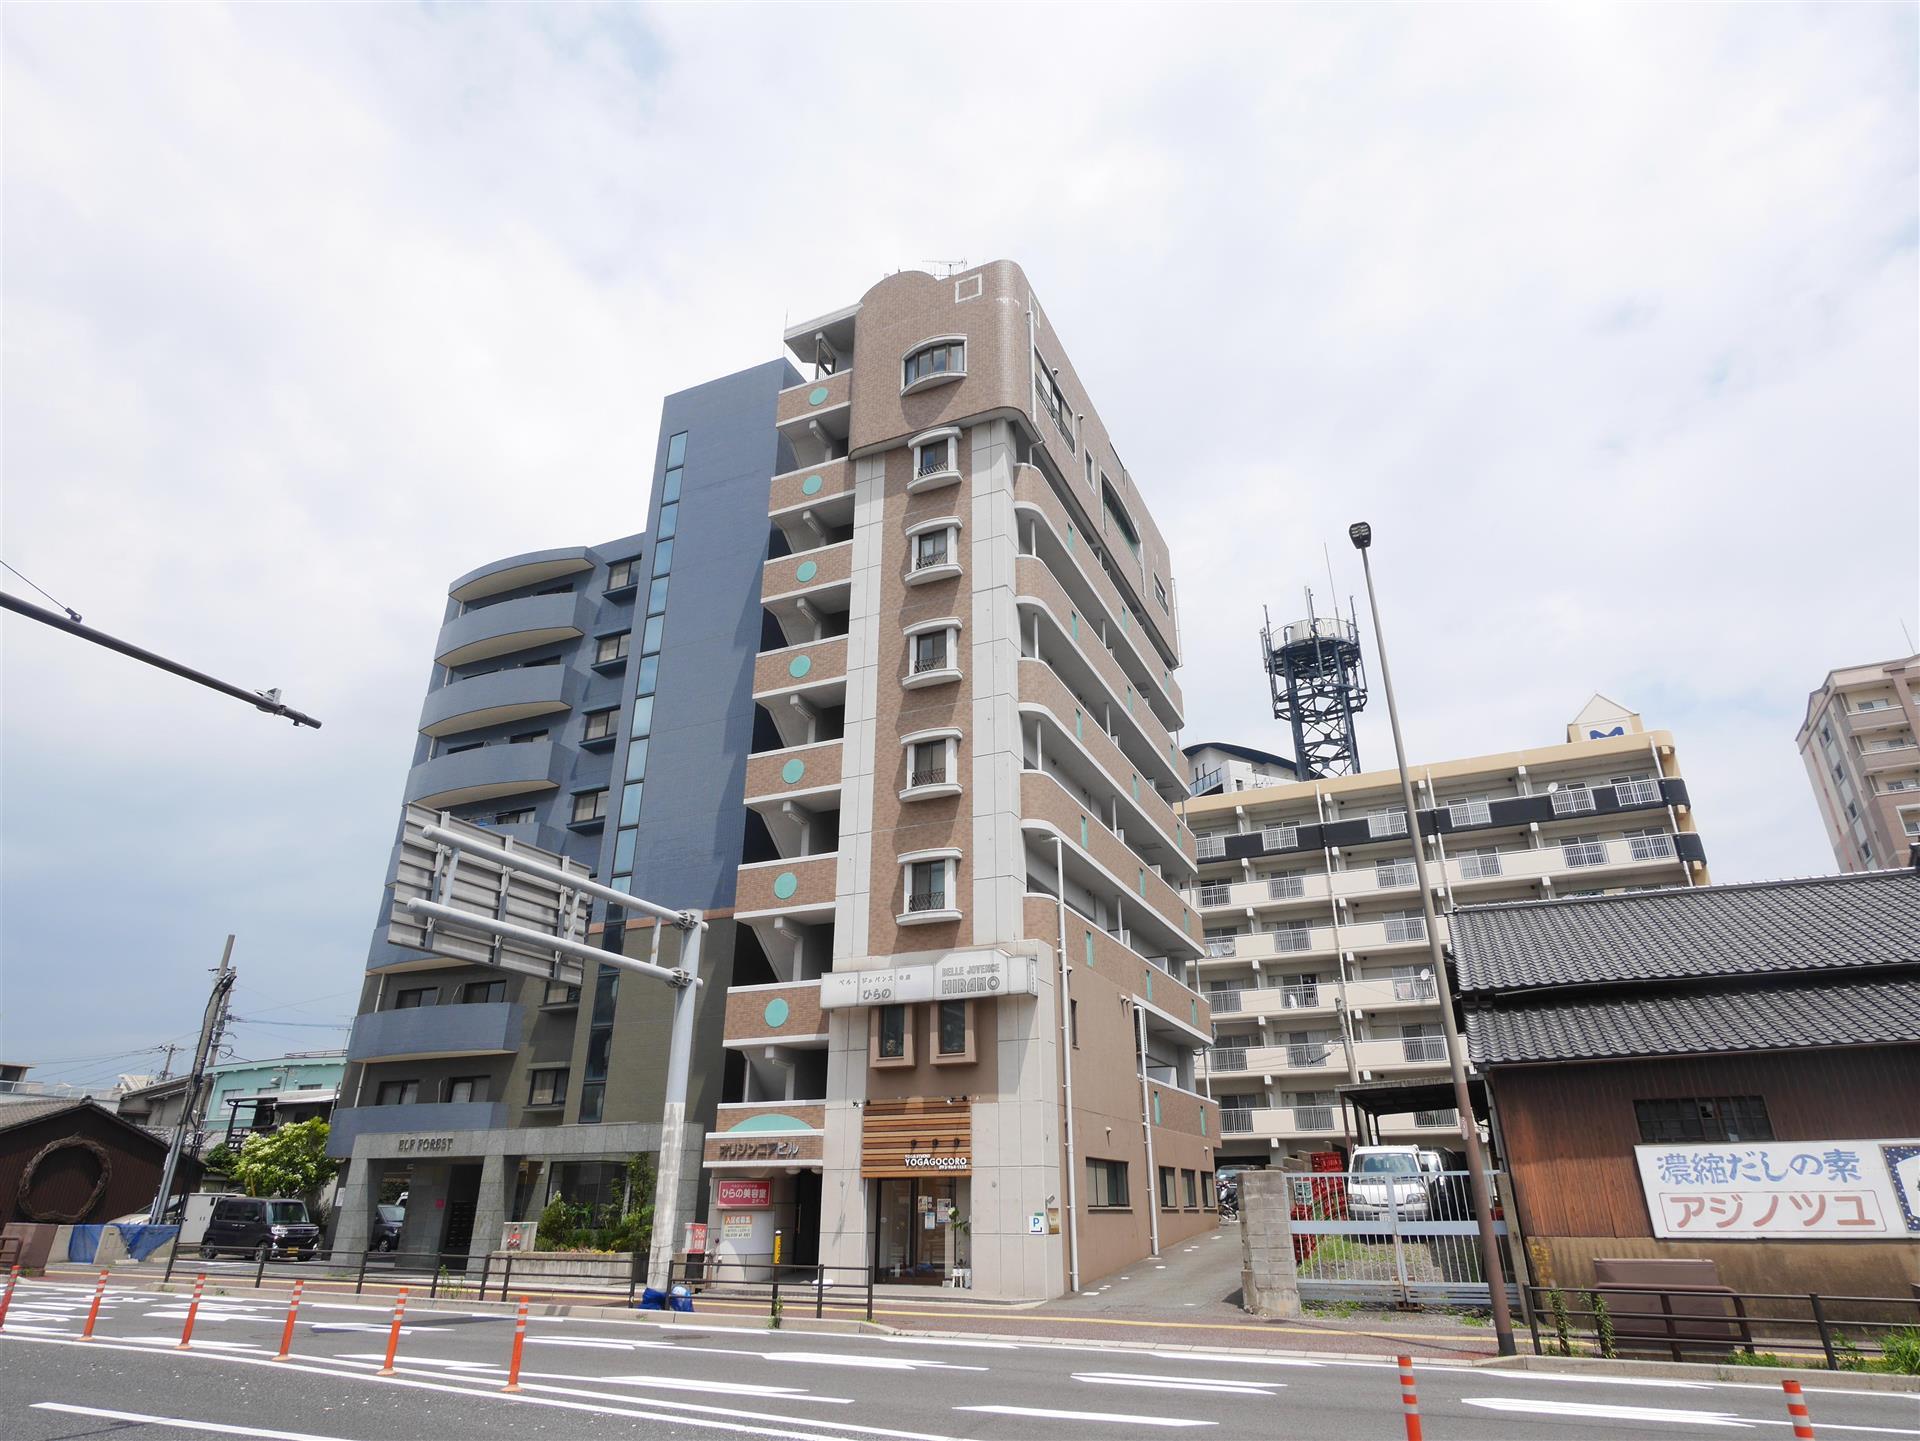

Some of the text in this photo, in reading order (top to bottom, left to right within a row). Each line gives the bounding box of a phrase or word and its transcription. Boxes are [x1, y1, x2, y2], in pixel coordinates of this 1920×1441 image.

[942, 967, 964, 977] BELLE
[942, 976, 1000, 994] HIRANO
[863, 988, 892, 1000] ひらの
[418, 1138, 454, 1151] FOREST
[904, 1157, 968, 1167] YOGAGOCORO
[1656, 1149, 1862, 1186] 濃縮だしの素
[722, 1188, 767, 1199] ひらの美容室
[1669, 1194, 1877, 1229] アジノツユ
[1032, 1217, 1040, 1227] P
